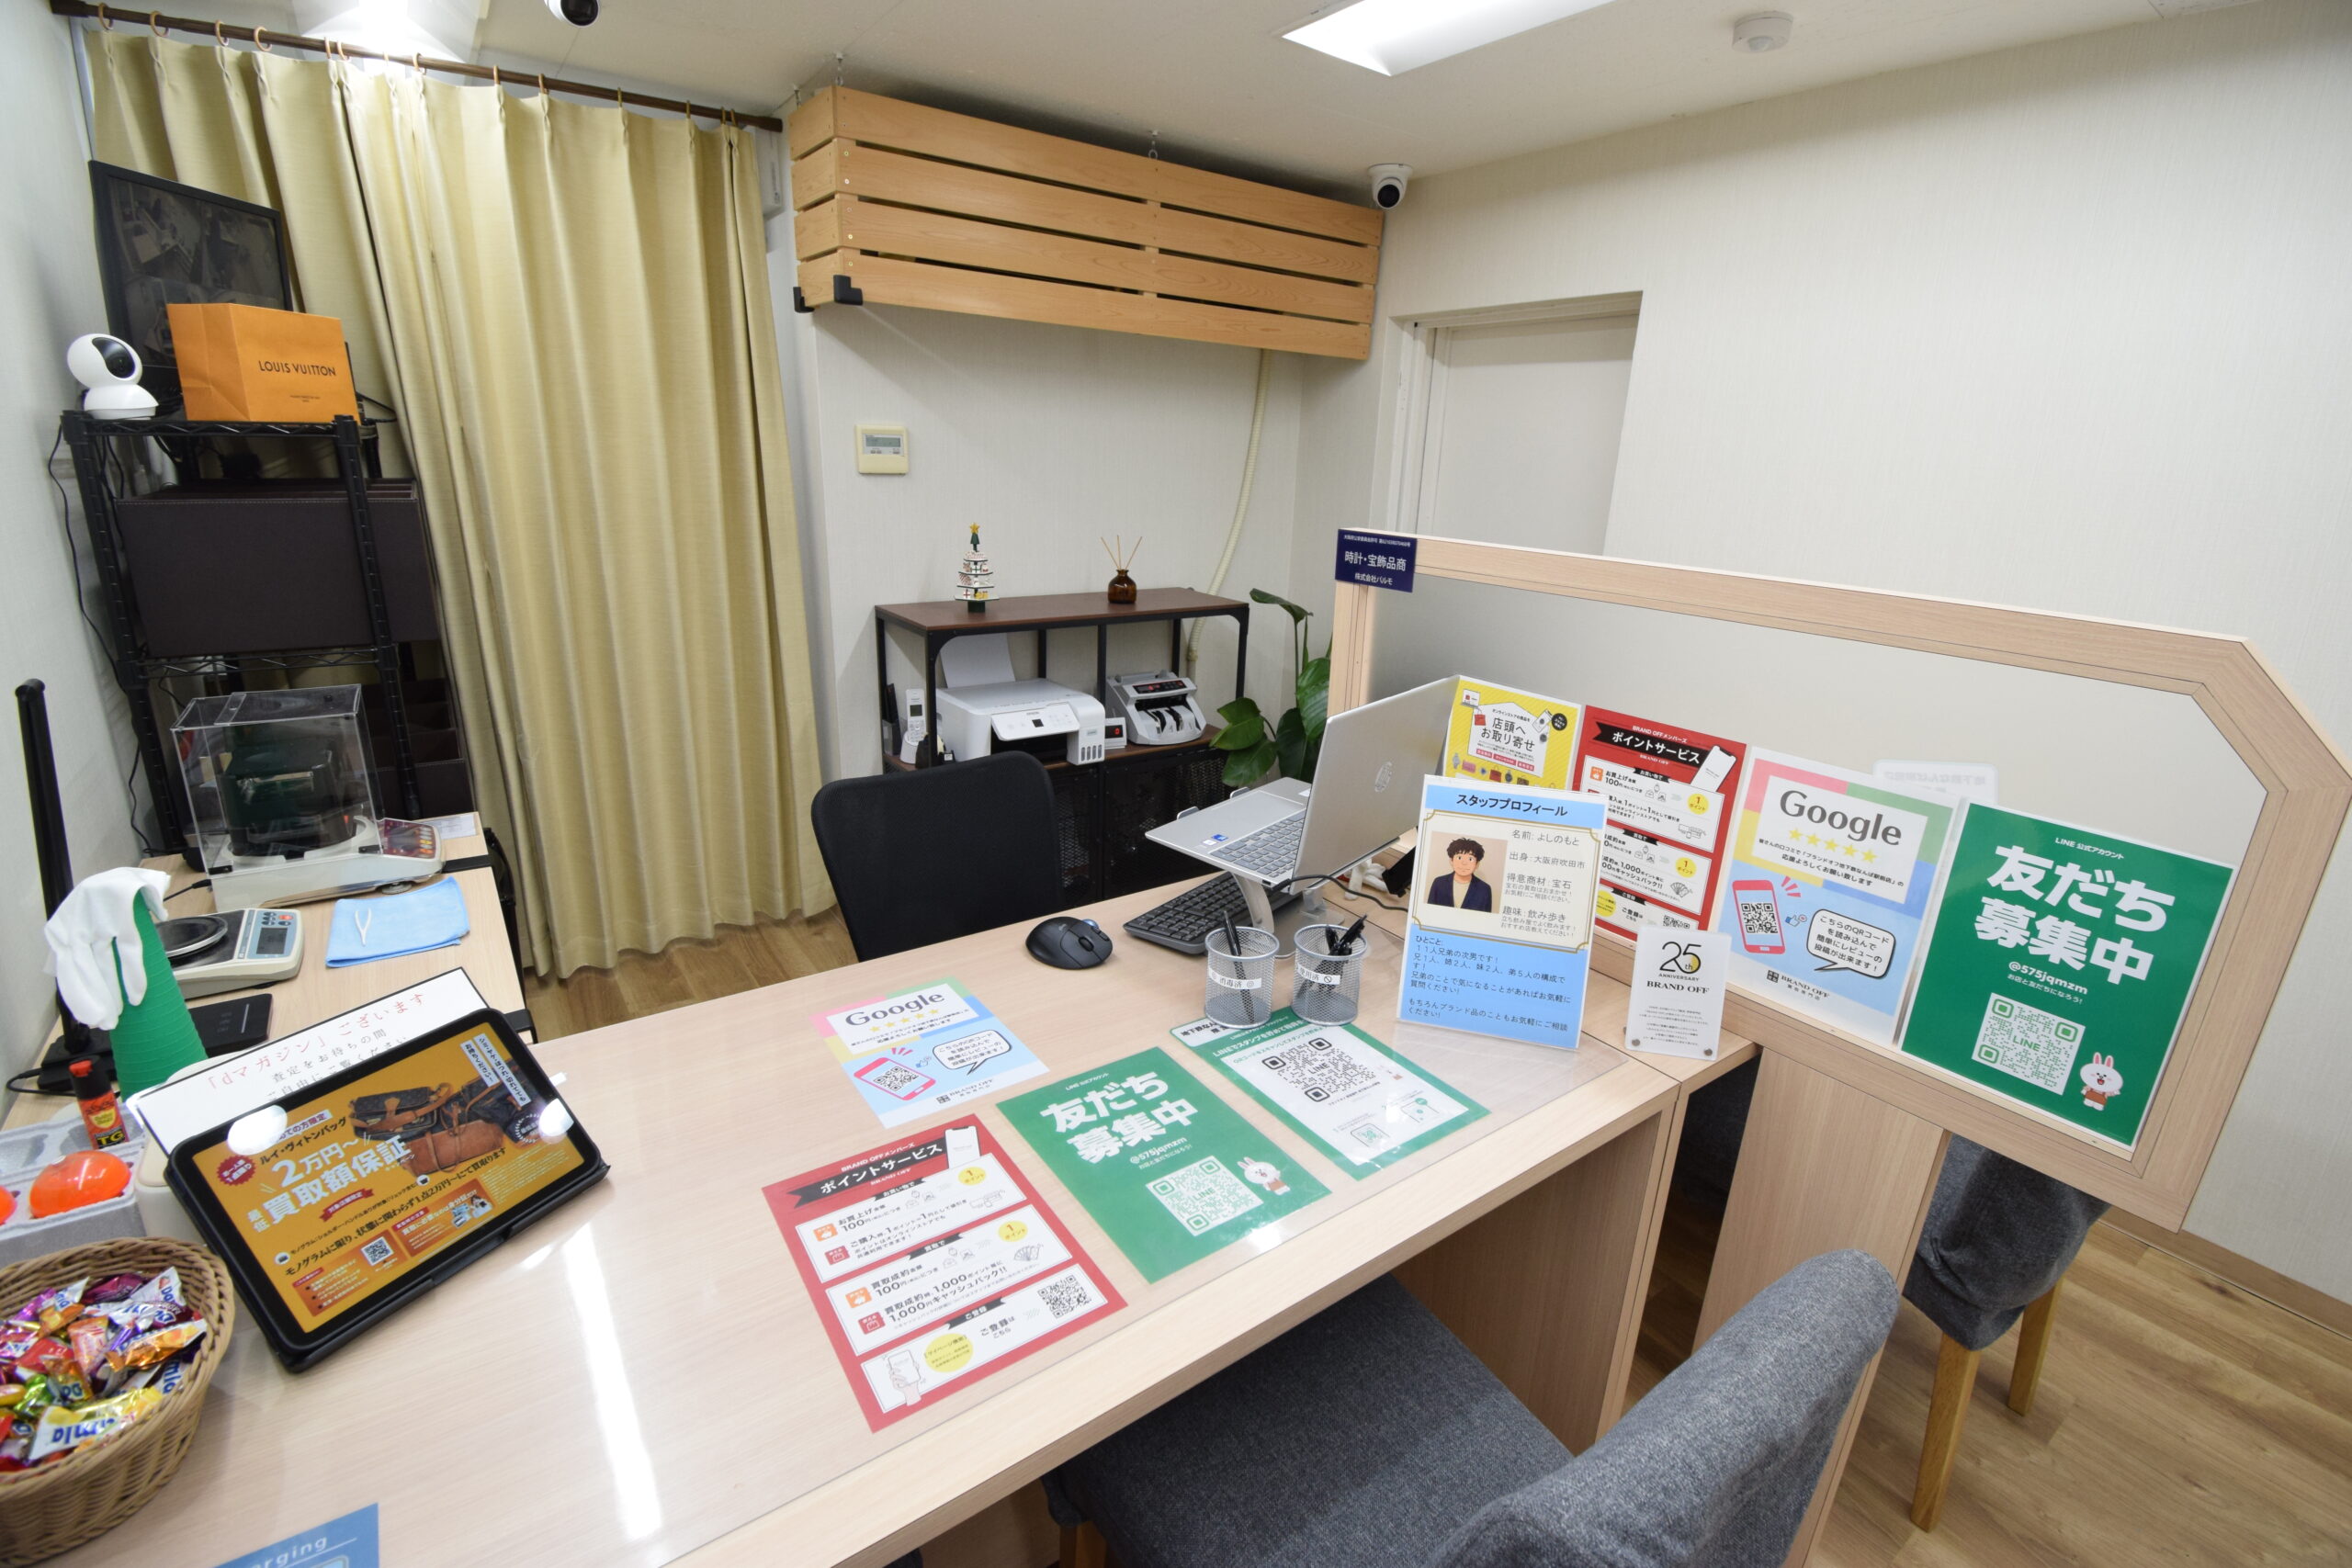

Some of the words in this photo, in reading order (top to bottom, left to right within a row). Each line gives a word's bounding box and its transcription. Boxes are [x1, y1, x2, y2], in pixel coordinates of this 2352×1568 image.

[259, 361, 290, 374] LOUIS
[293, 365, 336, 377] VUITTON
[1344, 551, 1407, 571] 時計・宝飾品商
[1492, 717, 1526, 735] 店頭へ
[1633, 725, 1651, 735] BRAND
[1481, 728, 1534, 752] お取り寄せ
[1612, 731, 1700, 764] ポイントサービス
[1456, 793, 1568, 817] スタッフプロフィール
[1690, 803, 1705, 811] ポイント
[1780, 790, 1902, 846] Google
[2055, 837, 2075, 848] LINE
[2076, 841, 2125, 860] 公式アカウント
[1781, 853, 1873, 886] 応援よろしくお願い致します
[1986, 845, 2176, 932] 友だち
[1820, 916, 1889, 944] こちらのQRコード
[1827, 928, 1877, 951] を読み込んで
[1974, 897, 2154, 986] 募集中
[1814, 943, 1878, 971] 投稿が出来ます！
[1816, 934, 1883, 964] 簡単にレビューの
[1411, 970, 1571, 1003] 兄弟のことで気になることがあればお気軽に
[1646, 980, 1684, 992] BRAND
[1688, 987, 1709, 995] OFF
[1658, 973, 1700, 982] ANNIVERSARY
[1781, 976, 1810, 990] BRAND
[1812, 987, 1829, 998] OFF
[2008, 961, 2088, 995] @575jqmzm
[845, 994, 945, 1026] Google
[1408, 998, 1568, 1032] もちろんブランド品のこともお気軽にご相談
[1181, 1021, 1217, 1037] 地下鉄なん
[2012, 1034, 2041, 1052] LINE
[272, 1029, 386, 1084] 査定をお待ちの間
[1308, 1062, 1329, 1075] LINE
[1065, 1082, 1079, 1091] LINE
[1040, 1071, 1169, 1133] 友だち
[96, 1130, 123, 1145] TG
[277, 1112, 326, 1141] めての方限定
[1067, 1099, 1198, 1164] 募集中
[260, 1116, 347, 1166] ルイ・ヴィトンバッグ
[1129, 1136, 1188, 1164] @575jqmzm
[818, 1143, 943, 1194] ポイントサービス
[841, 1158, 868, 1171] BRAND
[263, 1134, 411, 1224] 買取額保証
[869, 1173, 896, 1186] BRAND
[963, 1172, 985, 1183] ポイント
[1193, 1186, 1217, 1201] LINE
[1003, 1227, 1026, 1240] ポイント
[1005, 1224, 1014, 1232] 1
[978, 1314, 1016, 1337] ご登録は
[991, 1325, 1012, 1339] こちら
